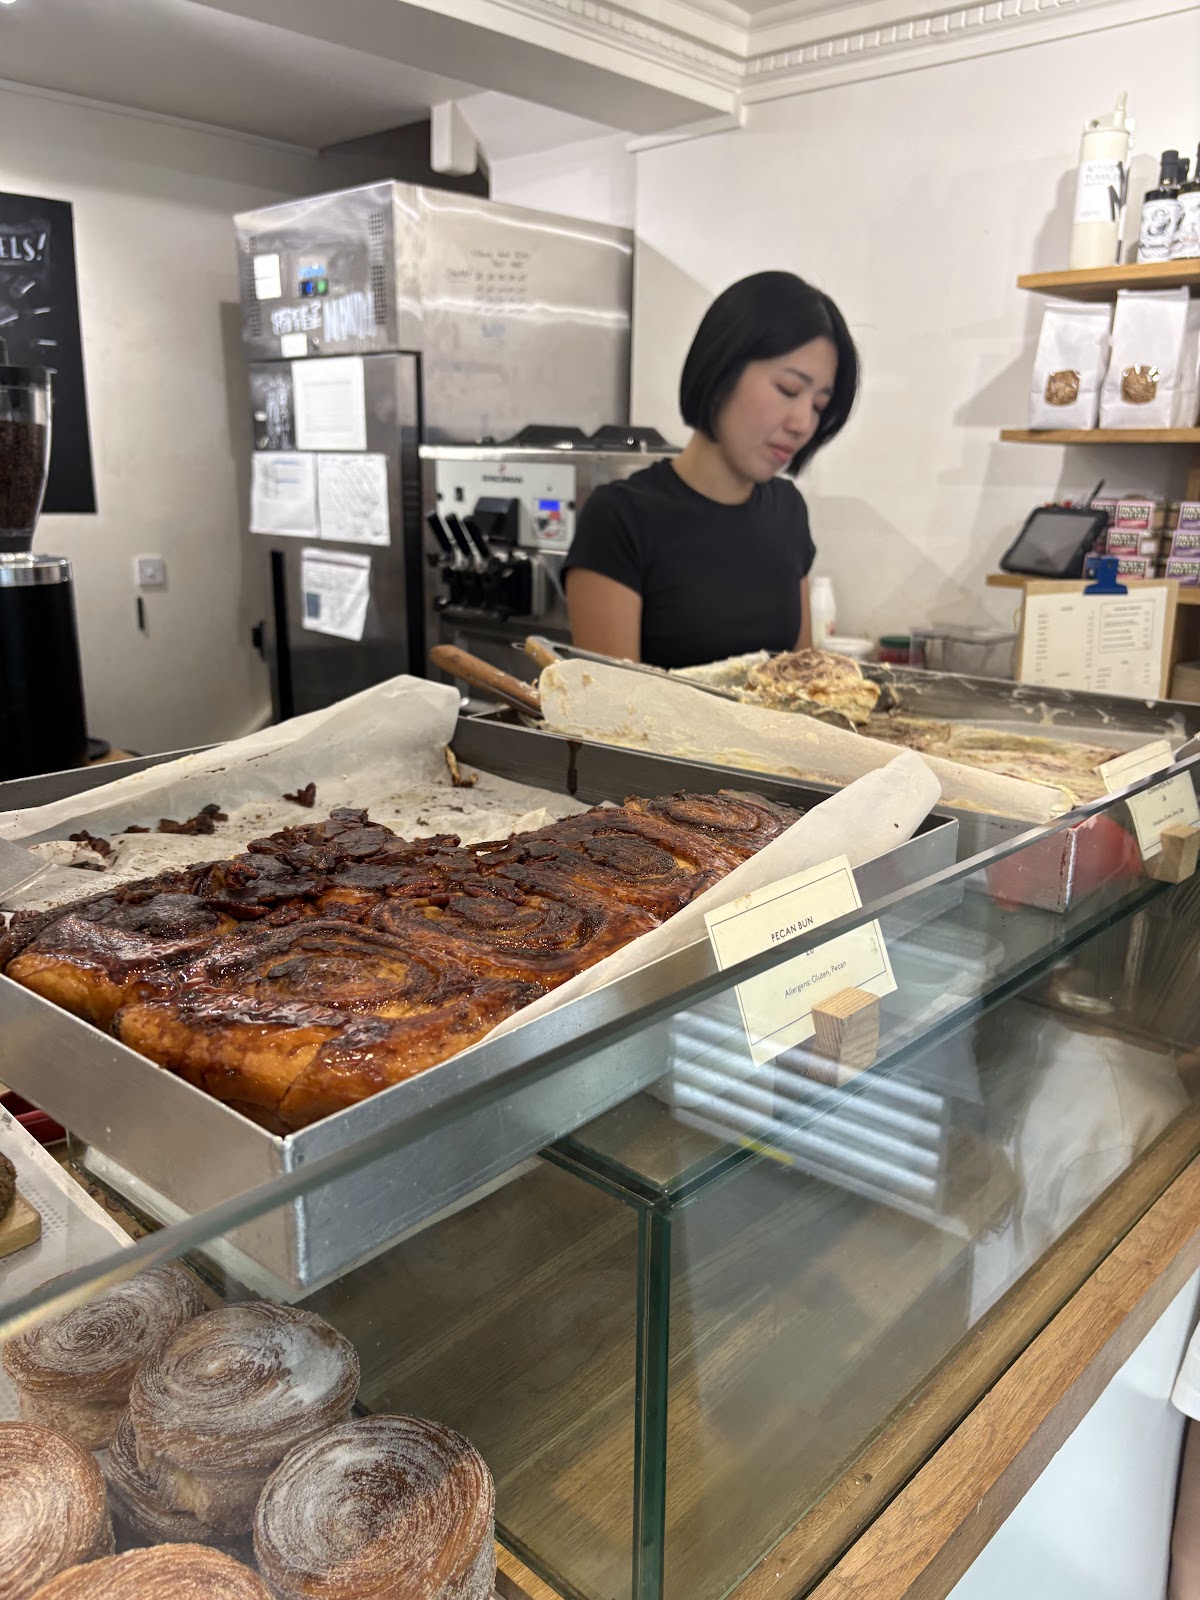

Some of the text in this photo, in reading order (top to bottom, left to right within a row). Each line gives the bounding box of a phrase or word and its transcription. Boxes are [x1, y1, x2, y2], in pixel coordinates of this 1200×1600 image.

[771, 916, 814, 942] PECAN BUN
[785, 961, 847, 998] Allergens: Gluten, Pecan
